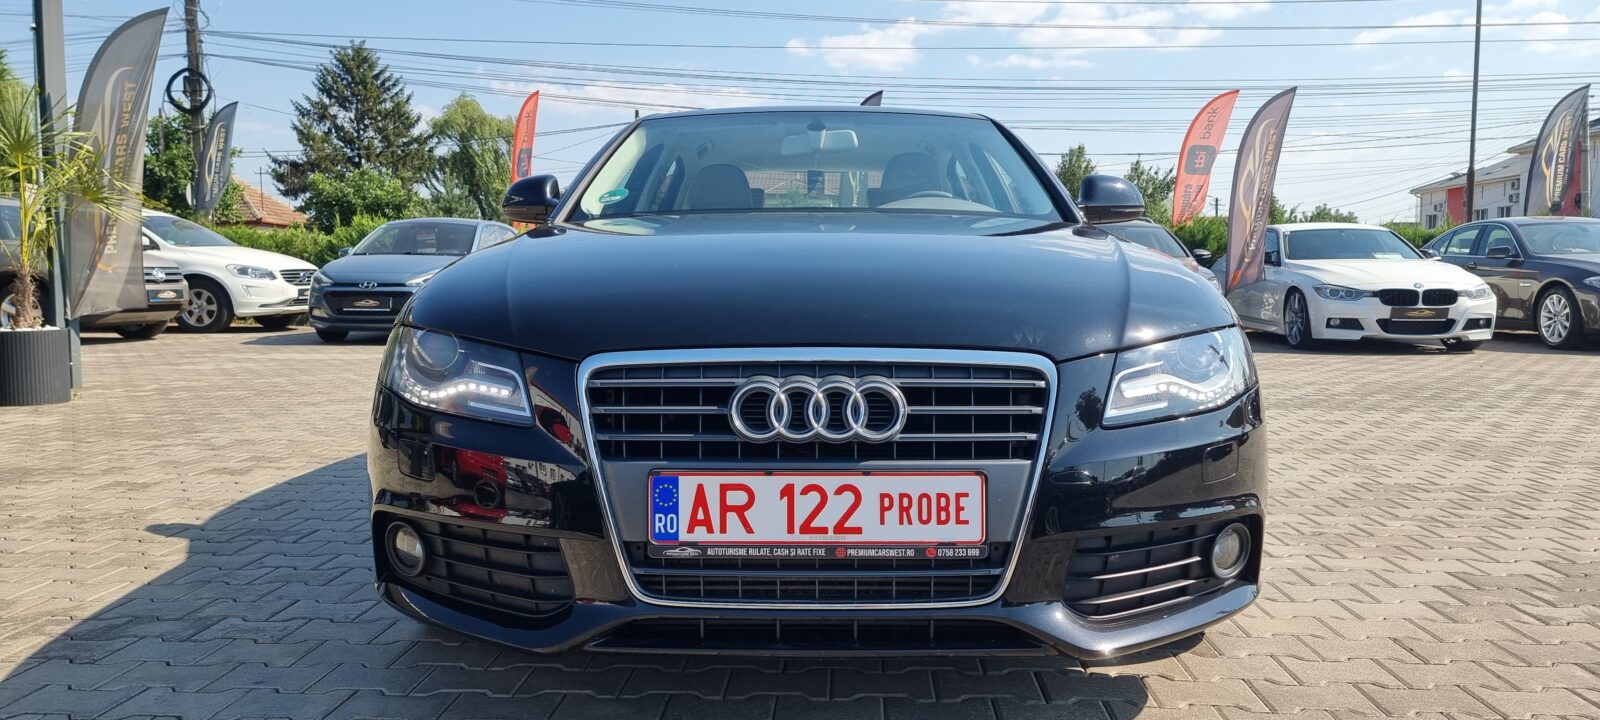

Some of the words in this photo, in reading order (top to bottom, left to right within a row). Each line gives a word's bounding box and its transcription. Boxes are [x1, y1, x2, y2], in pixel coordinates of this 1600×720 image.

[121, 80, 137, 128] WEST
[1200, 106, 1219, 140] bank
[218, 128, 226, 150] WEST
[1264, 127, 1277, 162] WEST
[1194, 150, 1207, 169] tbi
[1558, 140, 1568, 163] CARS
[1554, 163, 1565, 202] PREMIUM
[686, 483, 756, 535] AR
[779, 483, 863, 535] 122
[879, 492, 970, 526] PROBE
[654, 513, 677, 533] RO
[706, 547, 749, 556] AUTOTURISME
[748, 547, 773, 557] RULATE,
[773, 547, 789, 556] CASH
[797, 547, 812, 556] RATE
[812, 547, 826, 556] FIXE
[846, 548, 915, 557] PREMIUMCARSWEST.RO
[937, 548, 954, 557] 0758
[954, 548, 967, 557] 233
[967, 548, 980, 557] 699
